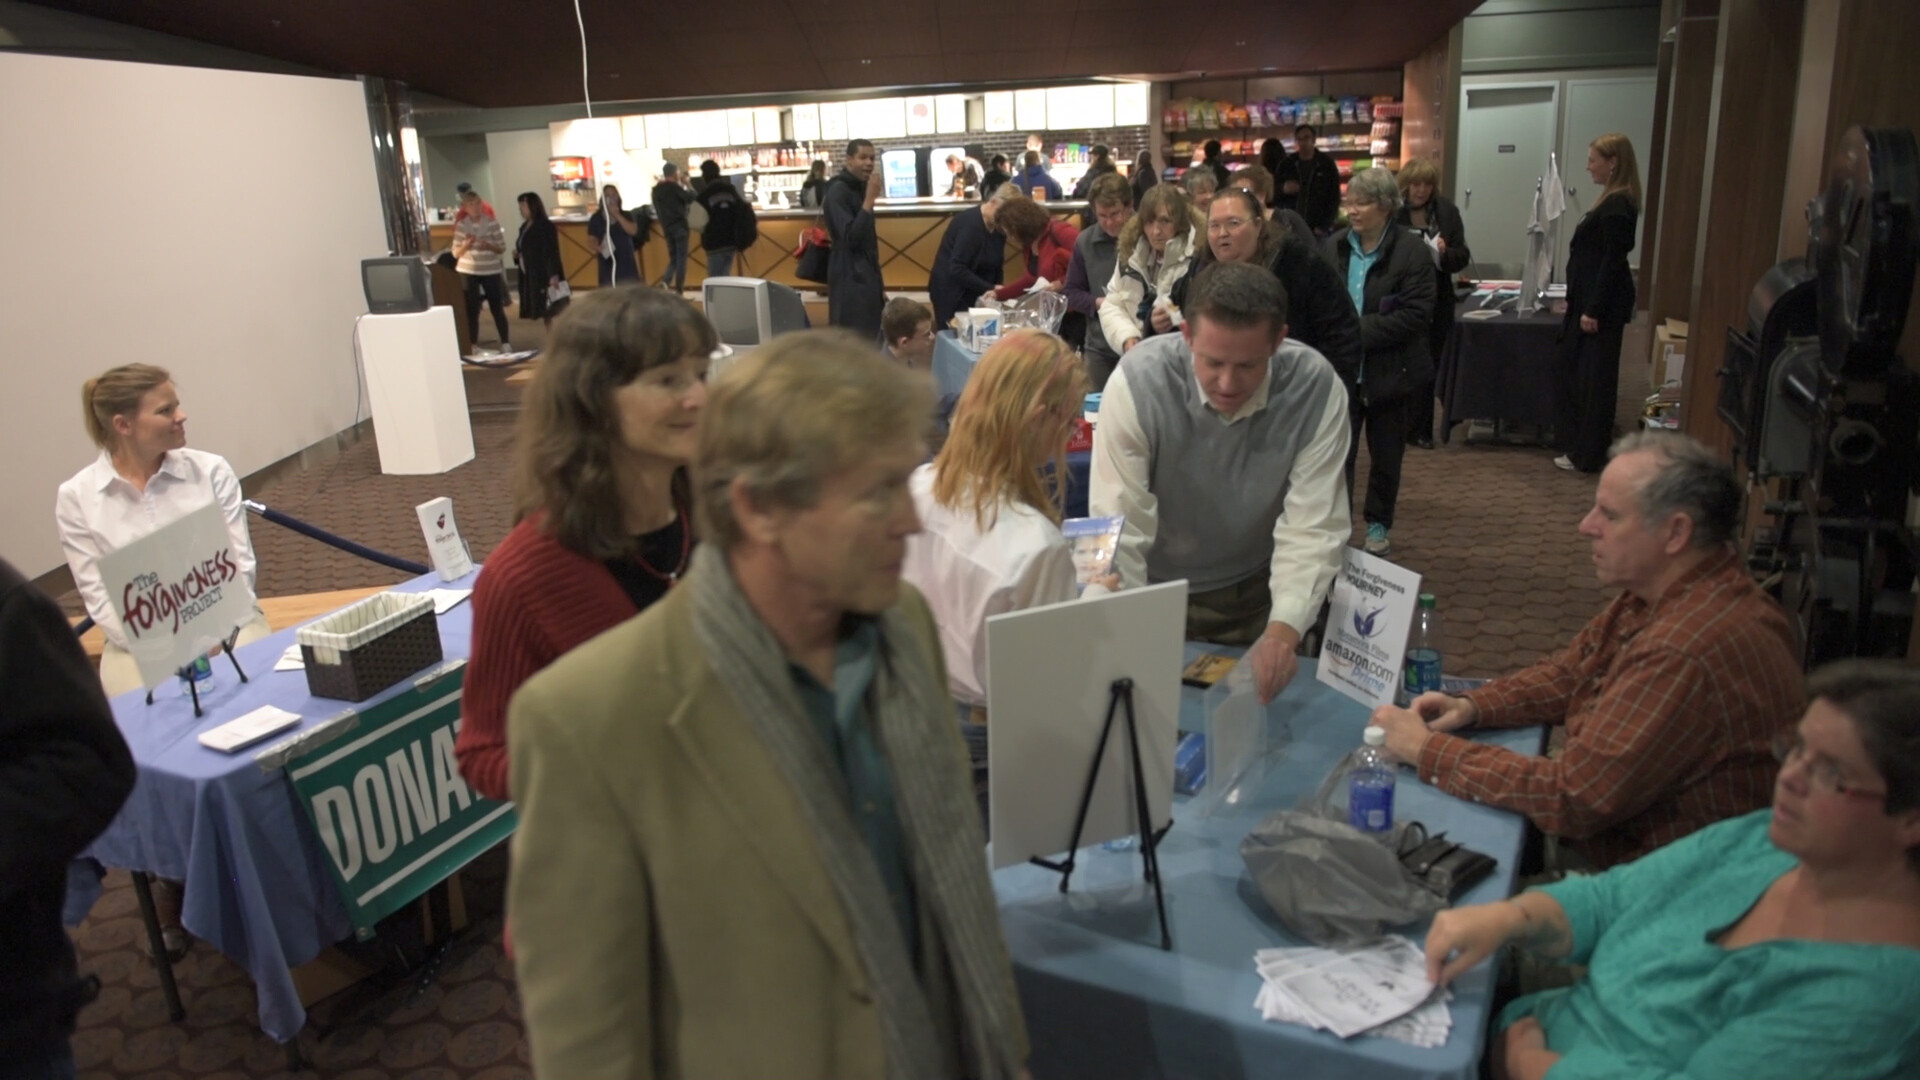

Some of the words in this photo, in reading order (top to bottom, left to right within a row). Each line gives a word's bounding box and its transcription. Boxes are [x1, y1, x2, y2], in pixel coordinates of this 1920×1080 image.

[133, 571, 159, 591] The
[1346, 574, 1387, 599] JOURNEY
[1347, 562, 1361, 575] The
[1361, 568, 1405, 594] Forgiveness
[180, 586, 223, 624] PROJECT
[1325, 639, 1394, 684] amazon.com
[1351, 665, 1386, 692] Prime
